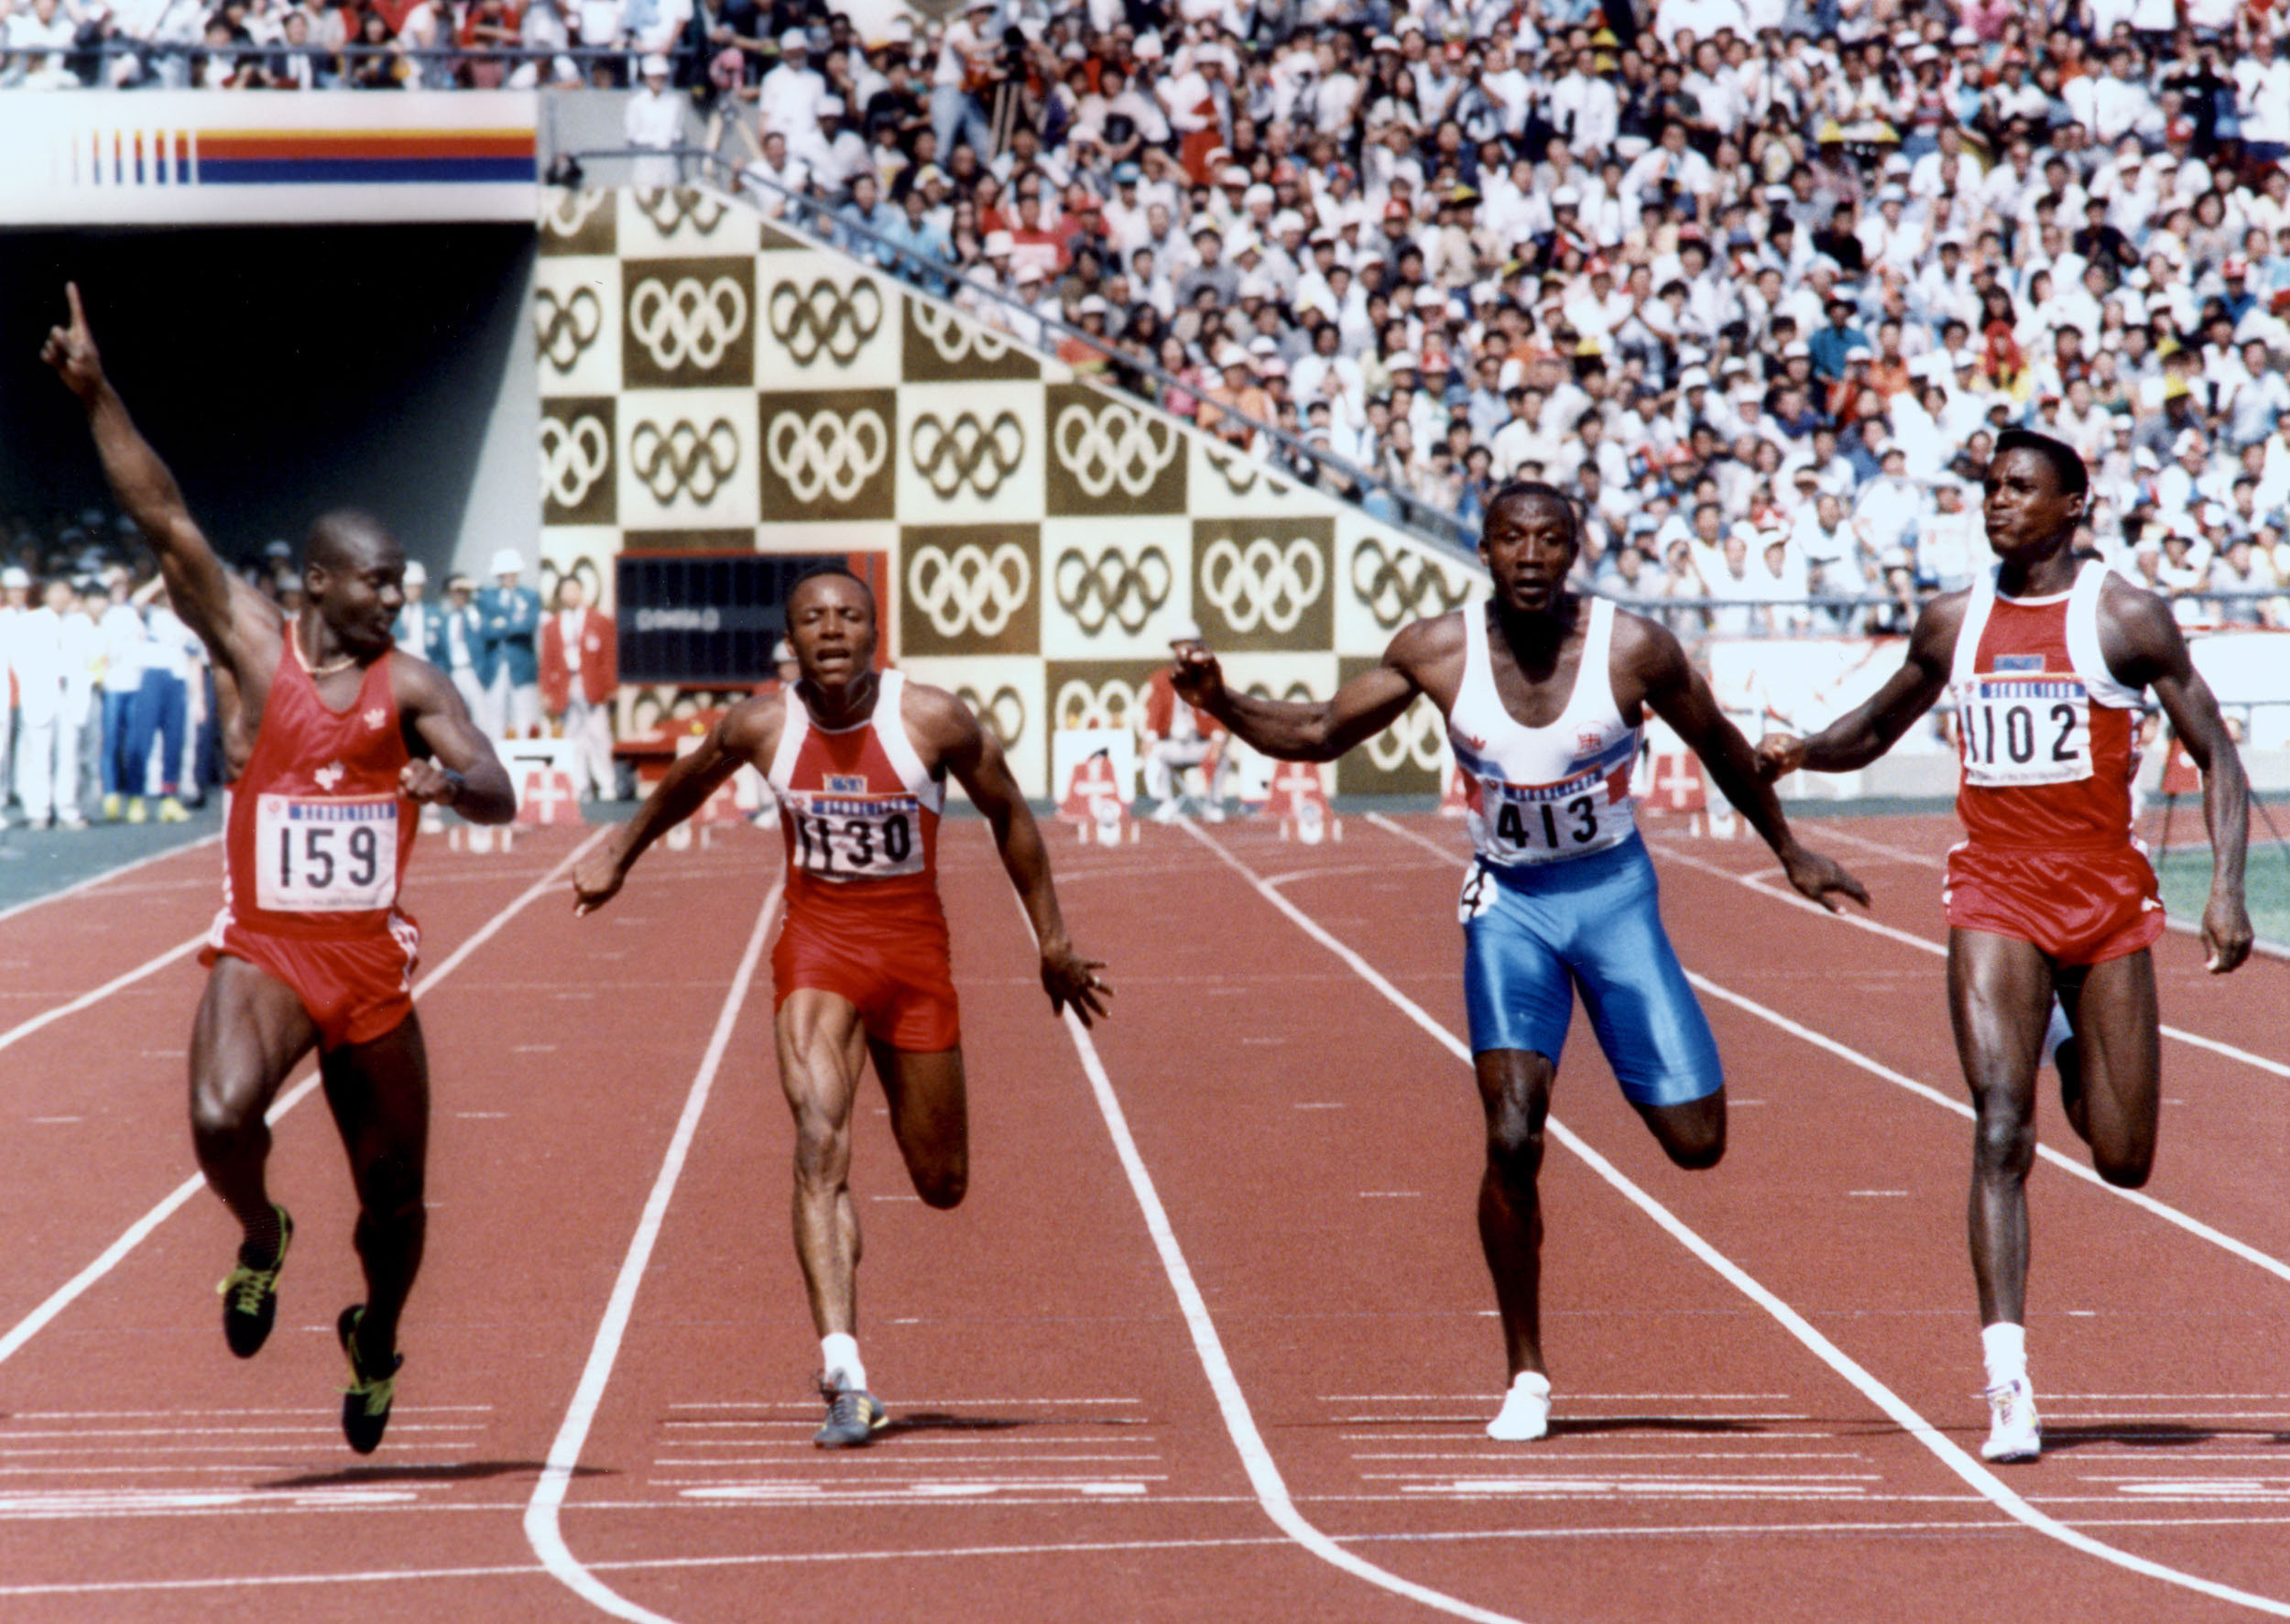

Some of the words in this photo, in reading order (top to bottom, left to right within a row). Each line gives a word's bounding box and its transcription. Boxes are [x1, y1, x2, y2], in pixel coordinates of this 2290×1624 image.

[1966, 703, 2078, 764] 1102
[797, 813, 911, 874] 1130
[1497, 796, 1598, 848] 413
[280, 826, 376, 888] 159
[1462, 866, 1486, 918] 4
